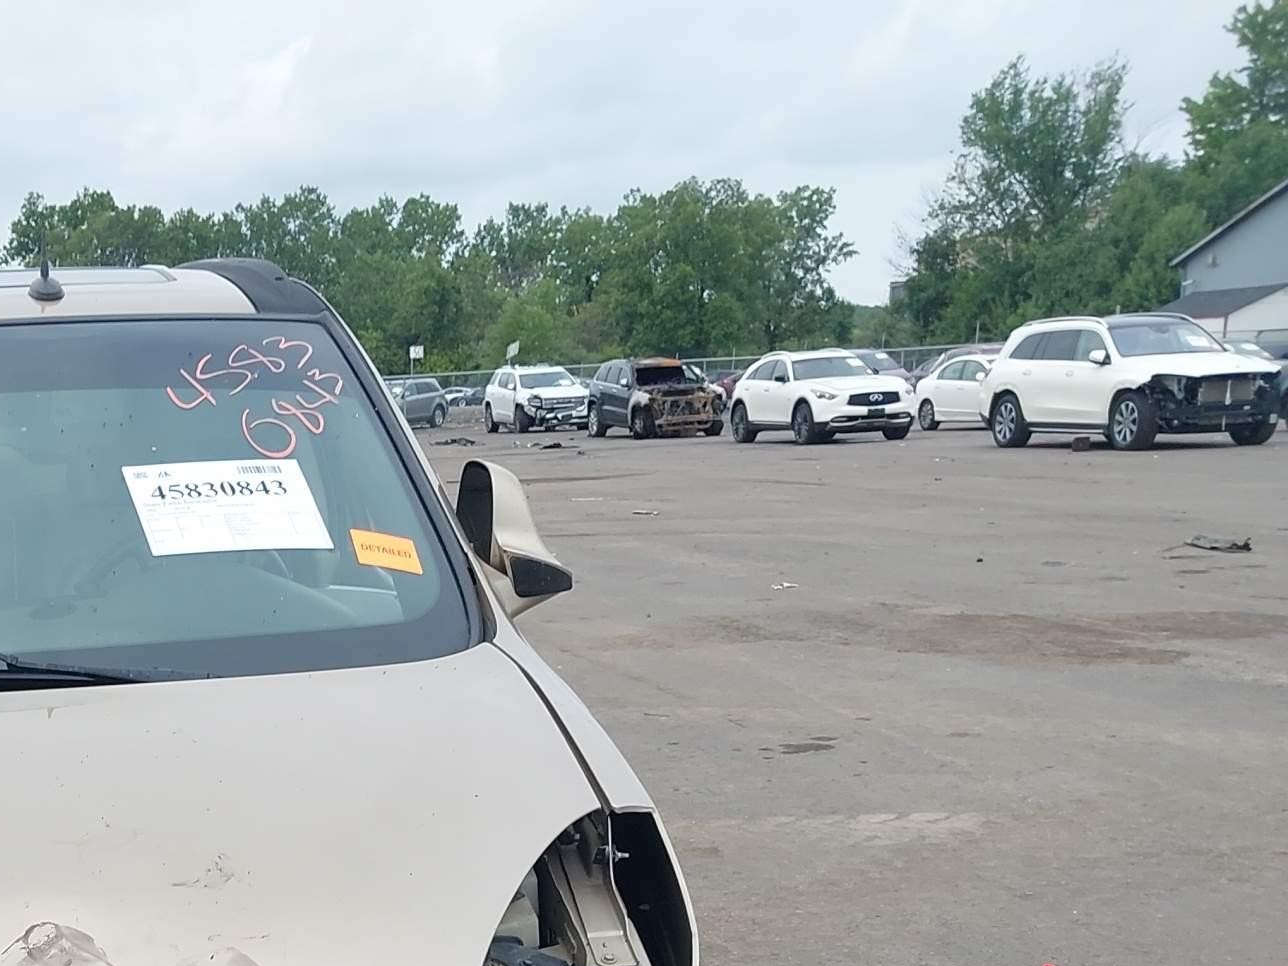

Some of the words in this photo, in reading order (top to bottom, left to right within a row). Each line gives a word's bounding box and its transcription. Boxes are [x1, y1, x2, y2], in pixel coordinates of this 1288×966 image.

[166, 336, 313, 410] 4583
[151, 479, 288, 500] 45830843
[360, 543, 412, 559] DETAILED
